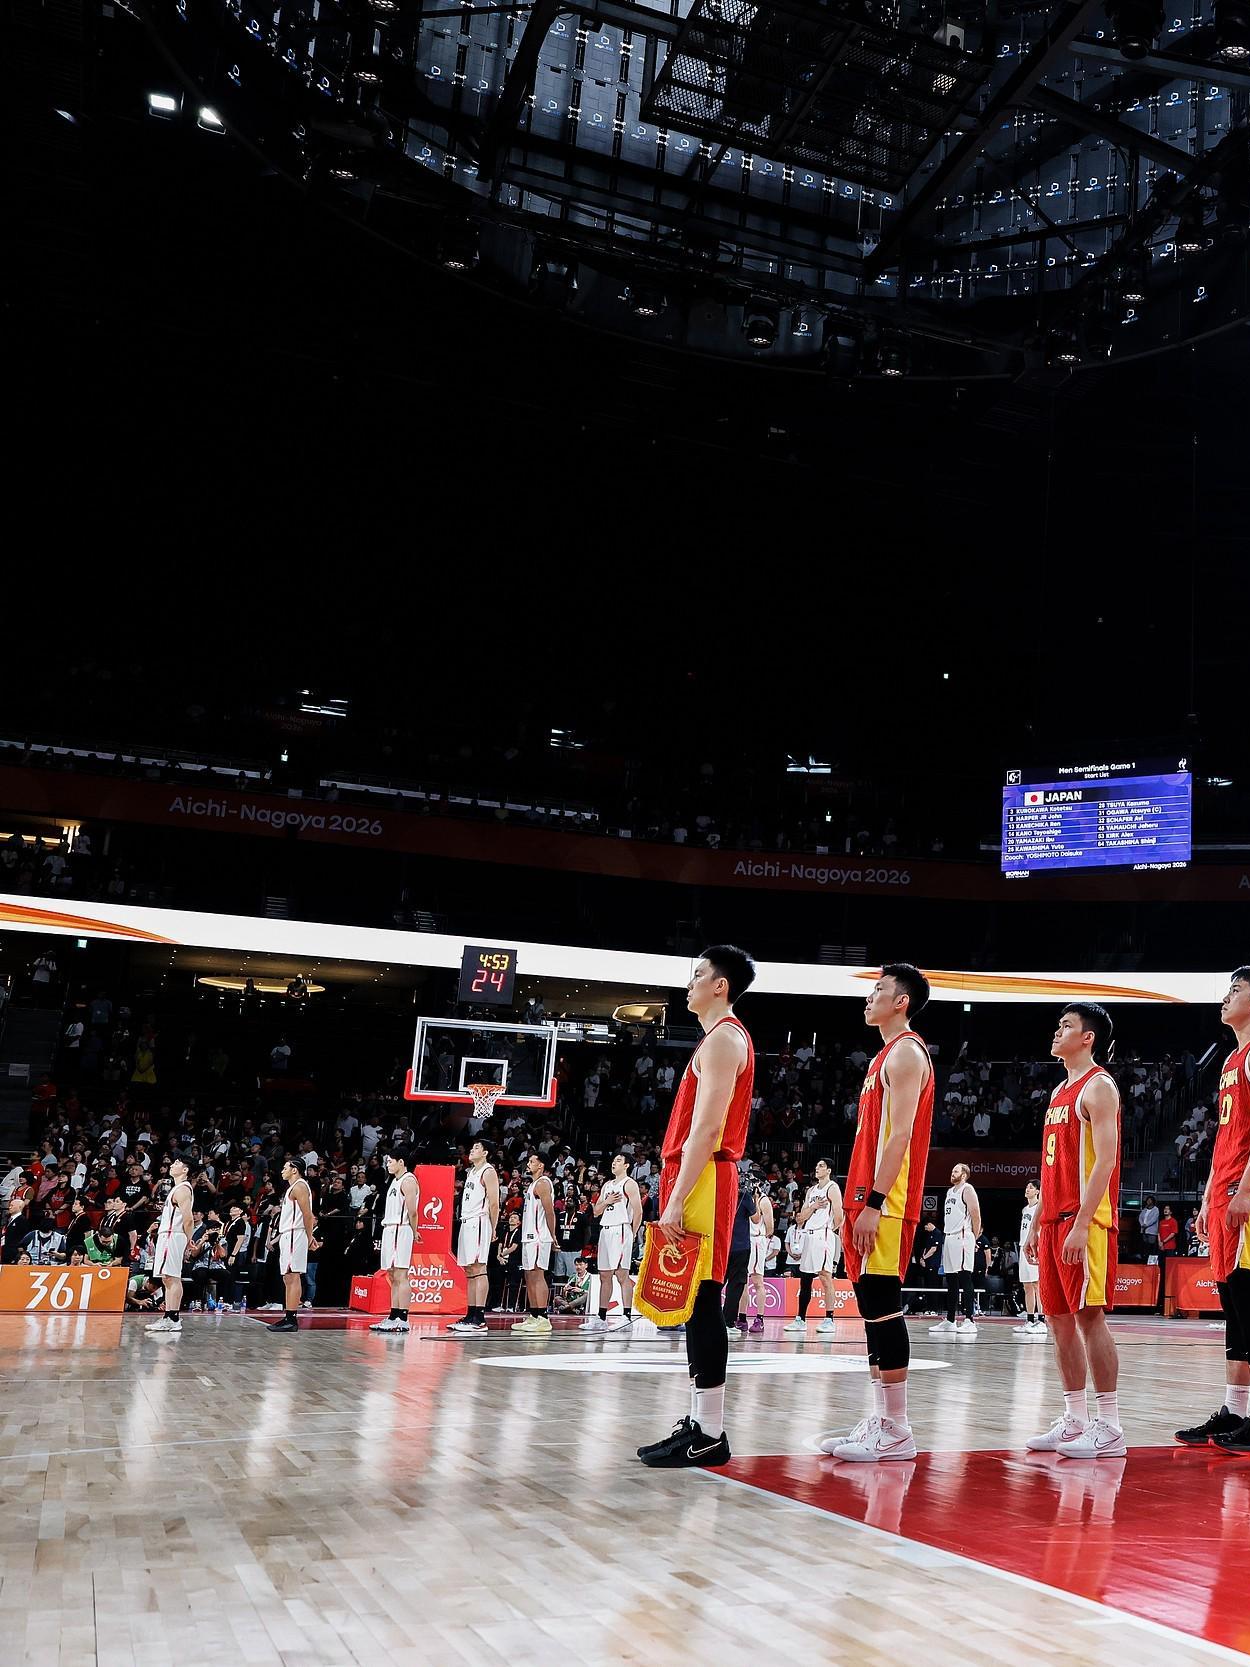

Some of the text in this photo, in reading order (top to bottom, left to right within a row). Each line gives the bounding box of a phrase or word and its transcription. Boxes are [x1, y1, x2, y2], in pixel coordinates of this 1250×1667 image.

[1074, 763, 1109, 773] Semifinals
[1110, 762, 1131, 771] Game
[1045, 791, 1082, 802] JAPAN
[169, 796, 385, 836] Aichi-Nagoya 2026
[1106, 823, 1137, 831] YAMAUCHI
[1133, 863, 1172, 871] Aichi-Nagoya
[734, 860, 912, 887] Aichi-Nagoya 2026
[479, 953, 509, 970] 4:53
[472, 969, 504, 992] 24
[1046, 1132, 1056, 1167] 9
[971, 1162, 1038, 1177] ichi-Nagoya
[408, 1265, 449, 1277] Aichi-
[409, 1279, 454, 1292] agoya
[651, 1277, 683, 1291] TEAM CHINA
[1114, 1284, 1129, 1292] 026
[652, 1285, 679, 1297] BASKETBALL
[410, 1292, 443, 1304] 2026
